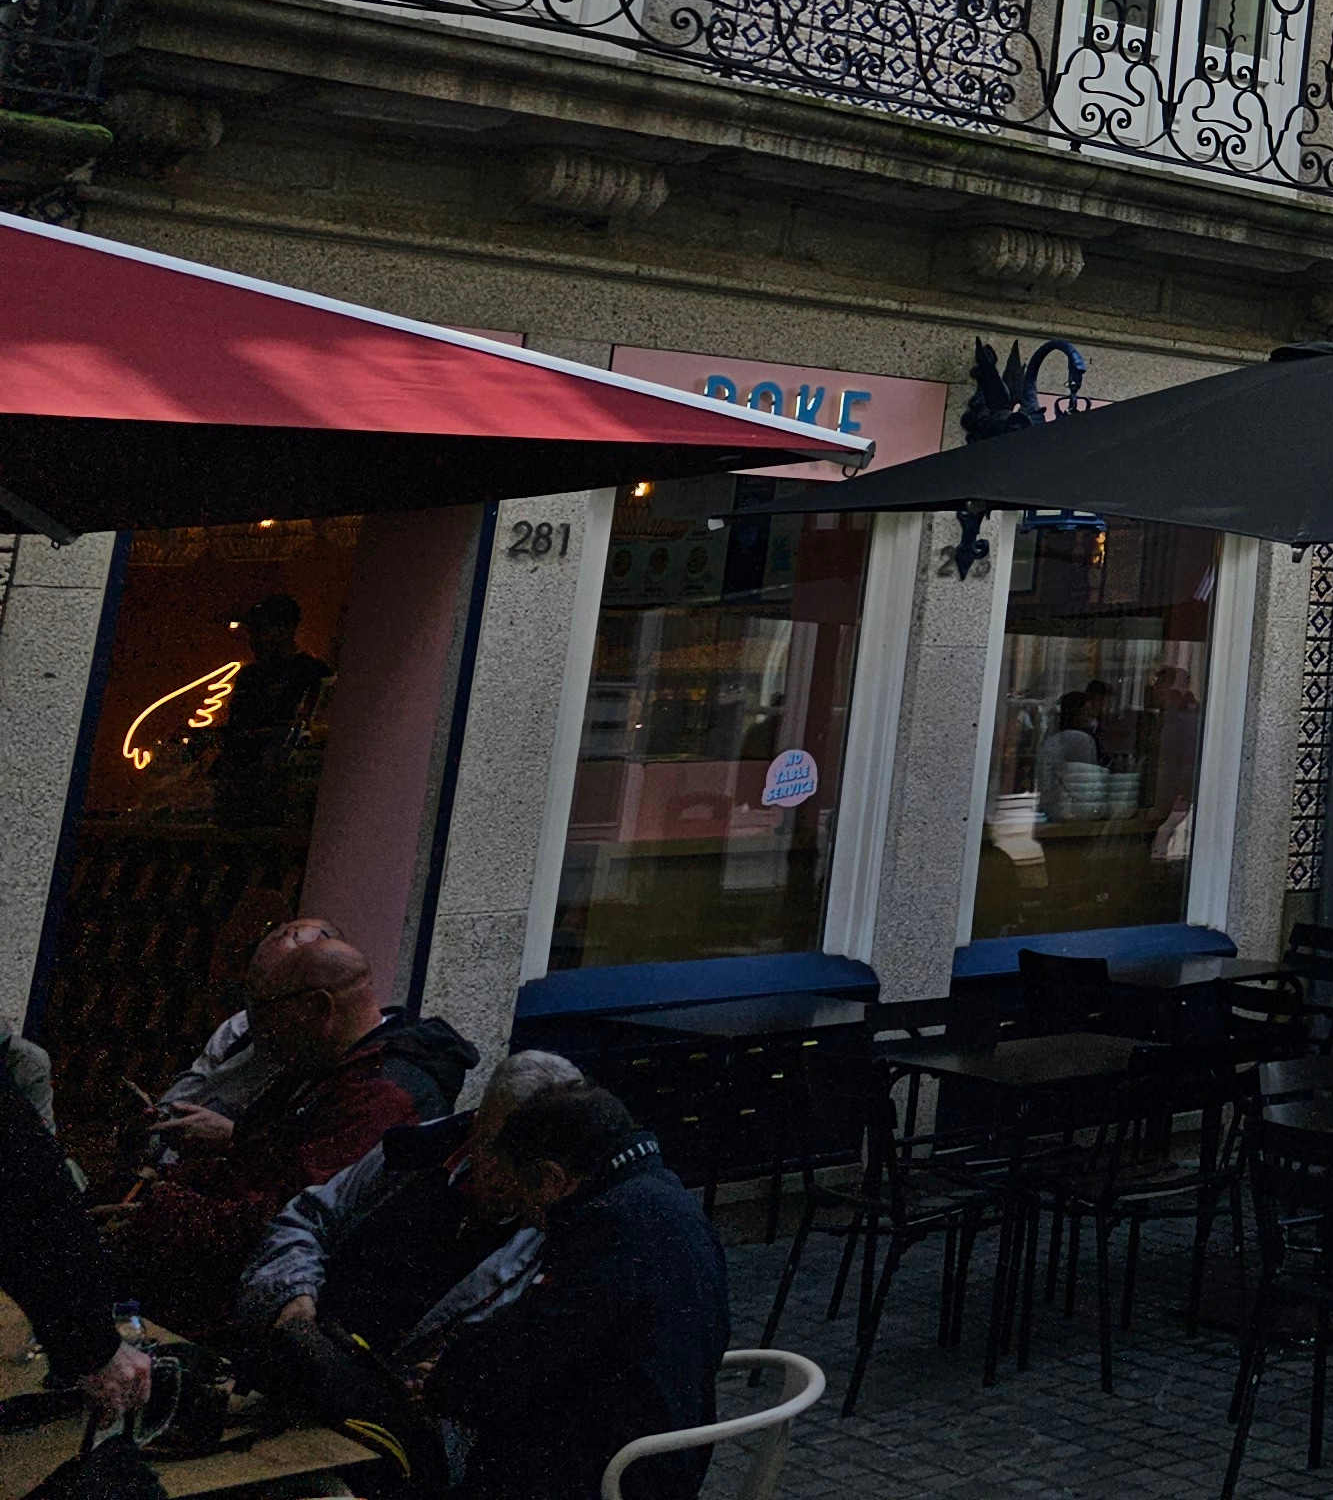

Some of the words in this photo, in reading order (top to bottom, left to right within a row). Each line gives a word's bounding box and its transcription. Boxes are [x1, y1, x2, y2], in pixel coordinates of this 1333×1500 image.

[507, 521, 571, 558] 281
[785, 752, 803, 767] NO
[775, 765, 810, 784] TABLE
[766, 780, 815, 802] SERVICE
